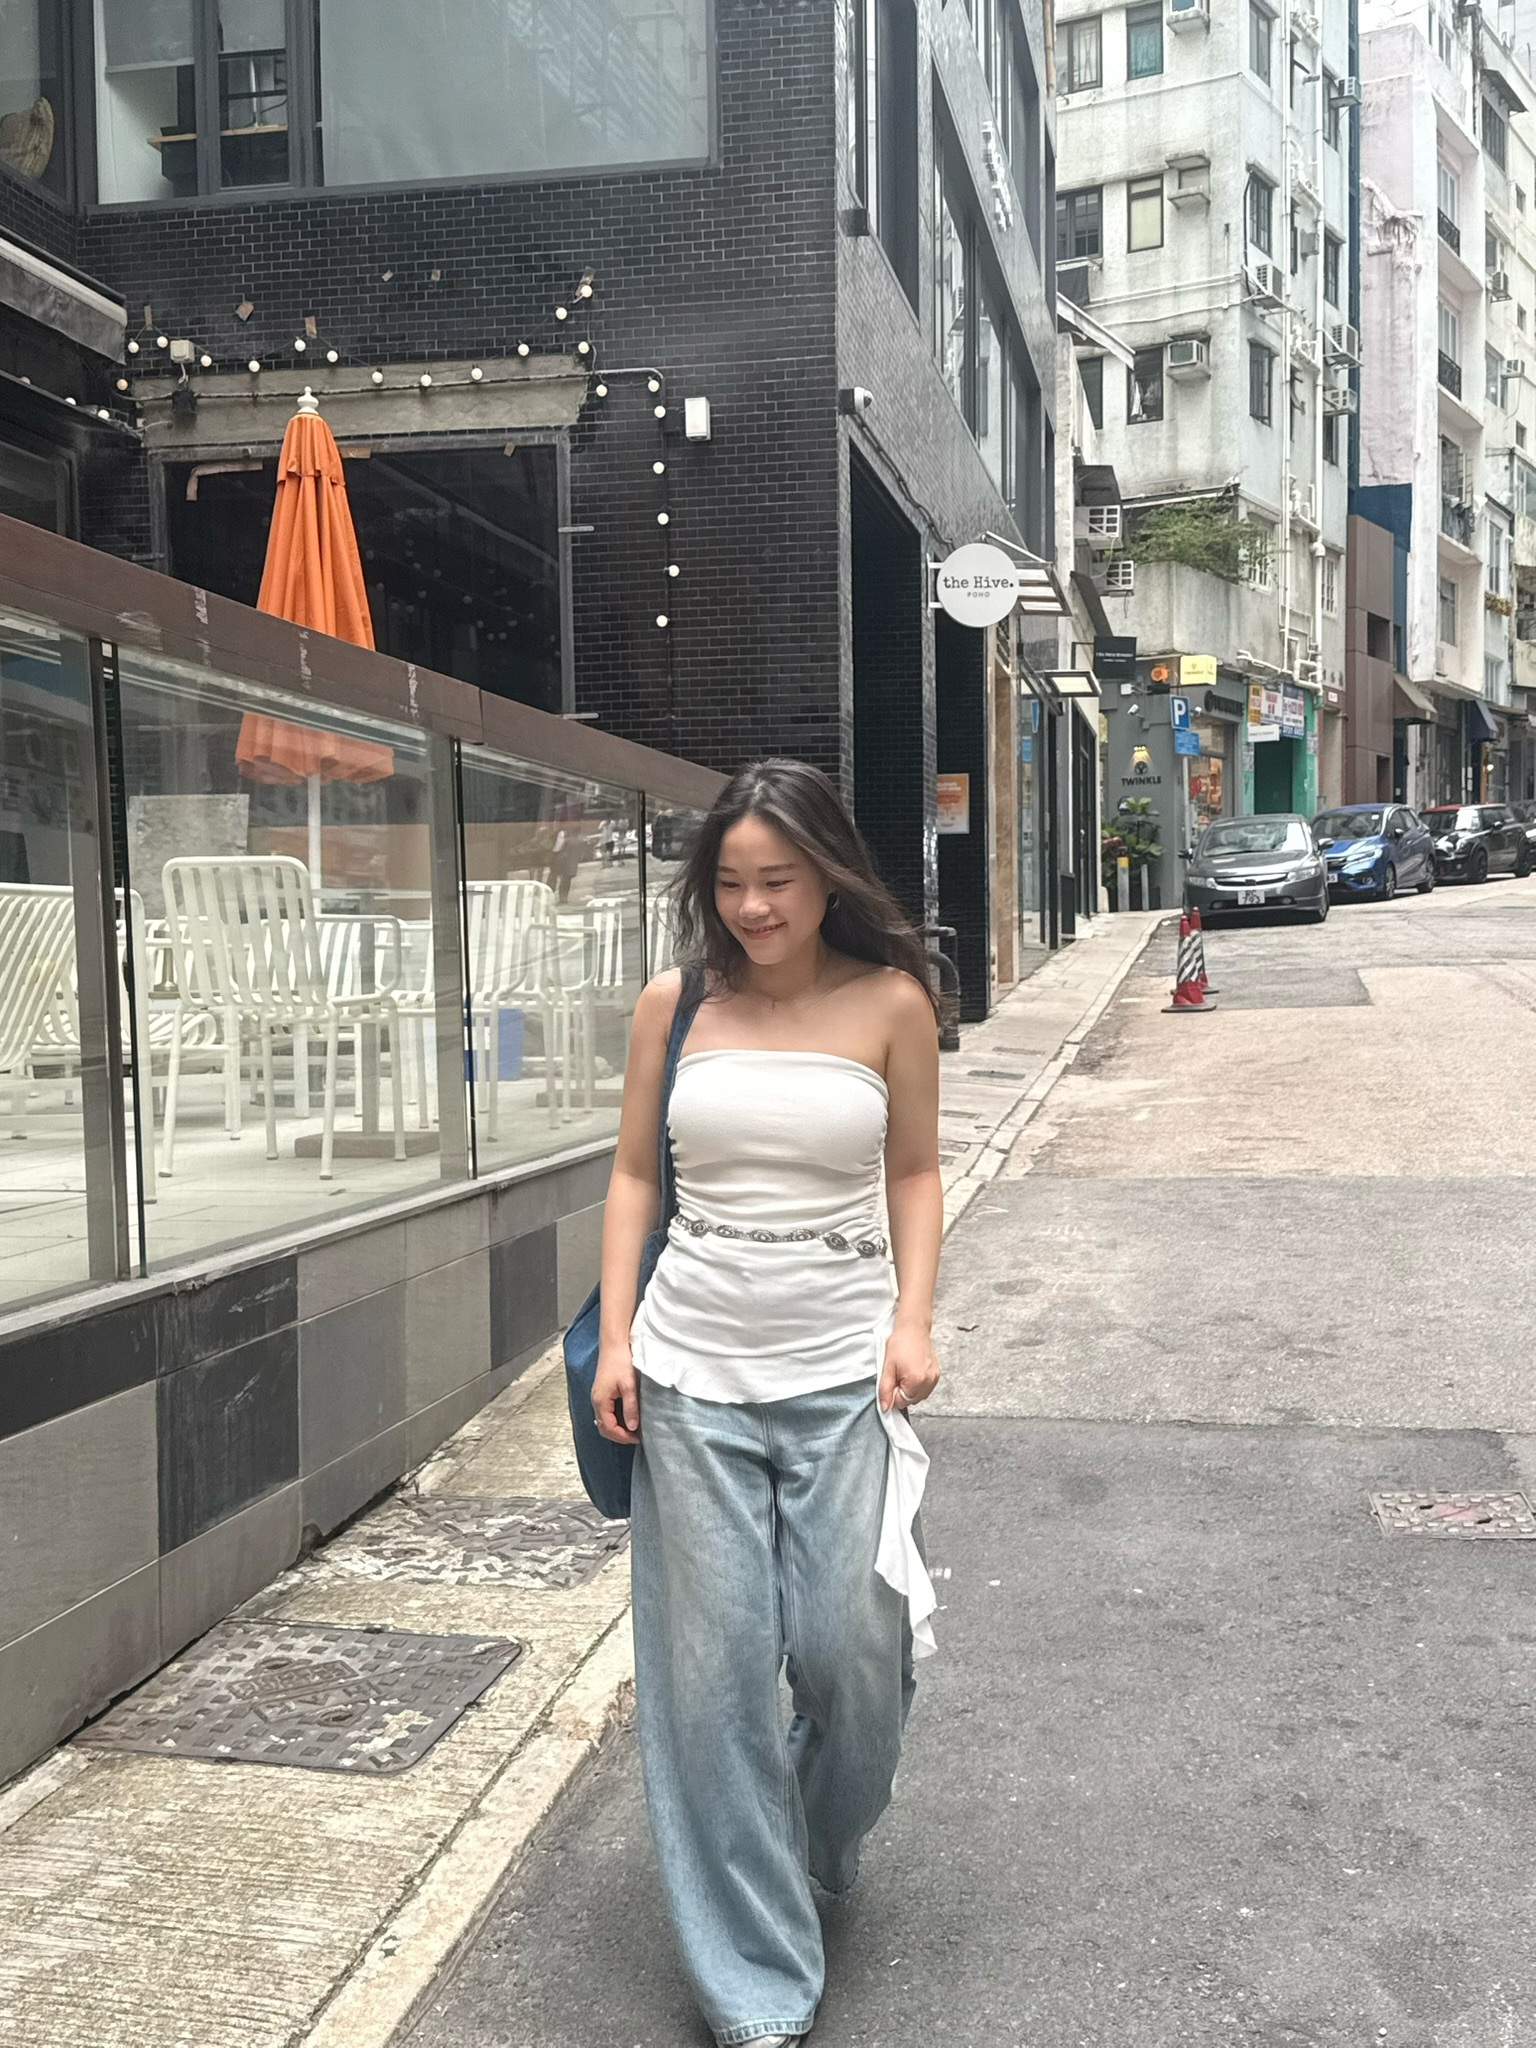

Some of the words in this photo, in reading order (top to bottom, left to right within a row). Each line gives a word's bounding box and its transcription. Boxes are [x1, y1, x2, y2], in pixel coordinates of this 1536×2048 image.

[943, 576, 969, 589] the
[973, 576, 1014, 589] Hive.
[1173, 699, 1186, 725] P
[1121, 776, 1162, 786] TWINKLE
